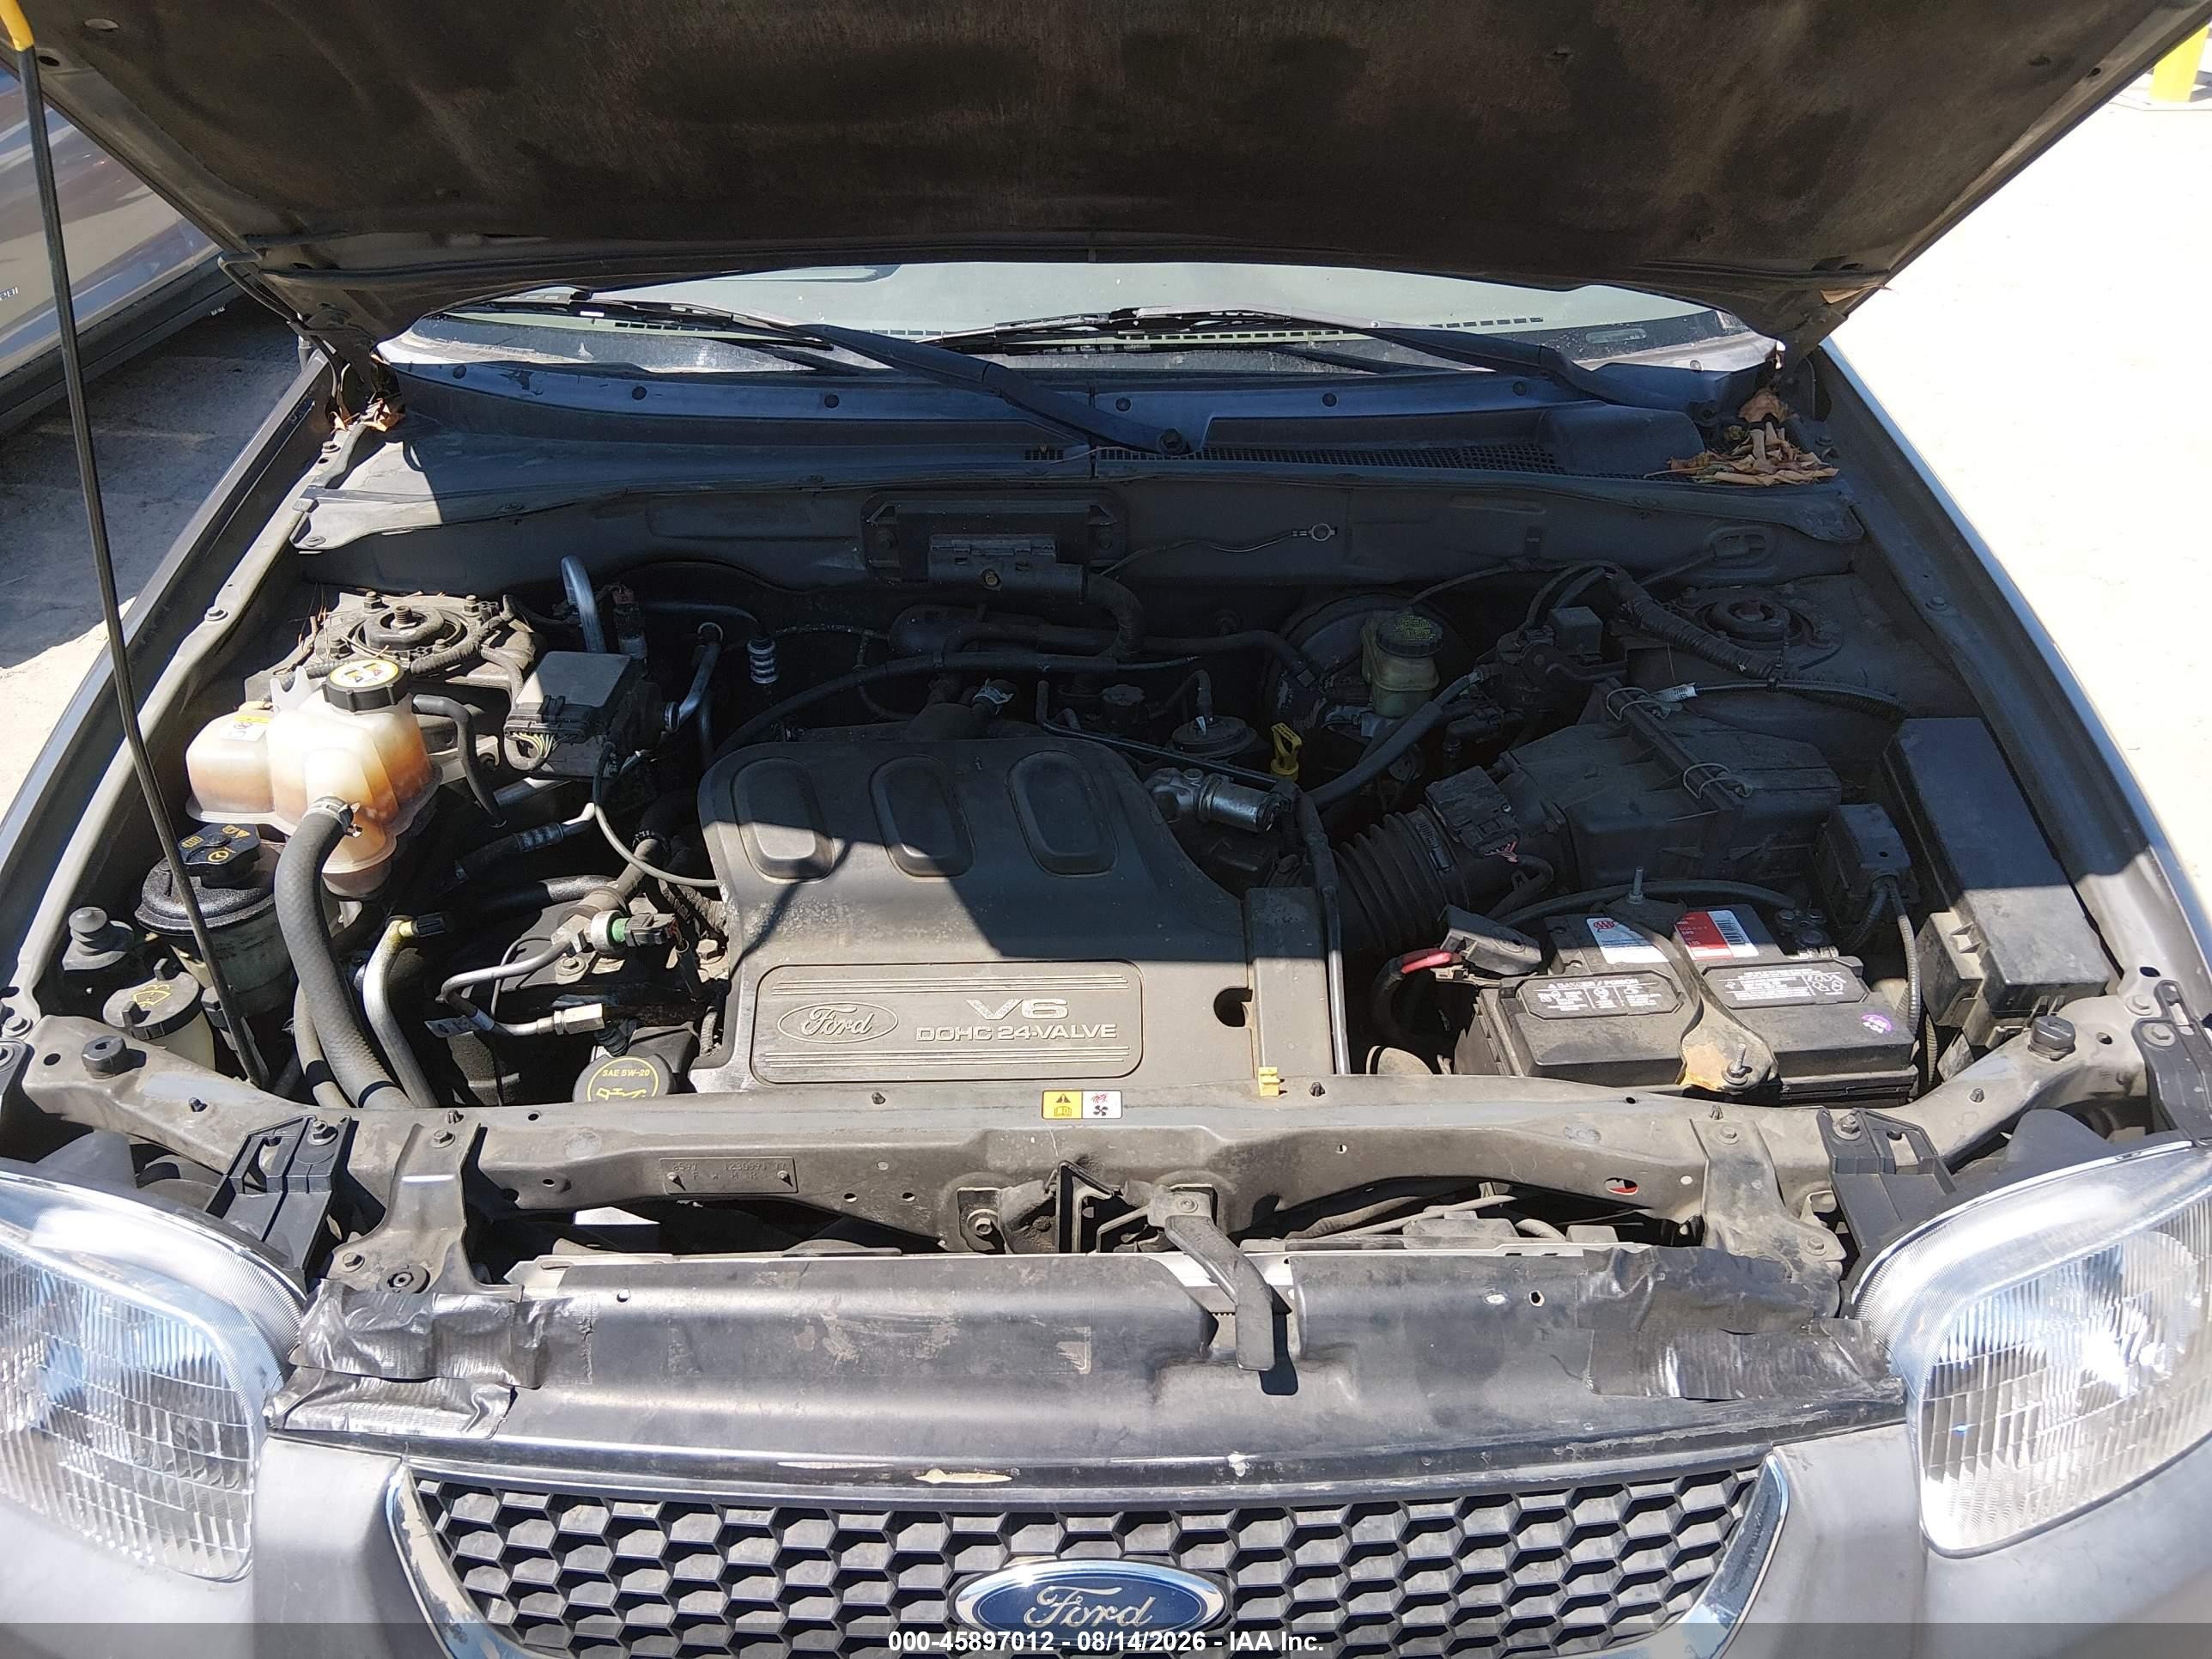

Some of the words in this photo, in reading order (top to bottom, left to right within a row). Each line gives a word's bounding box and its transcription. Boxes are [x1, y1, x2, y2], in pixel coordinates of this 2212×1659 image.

[801, 1006, 874, 1036] Ford
[965, 998, 1068, 1020] V6
[915, 1025, 994, 1042] DOHC
[997, 1023, 1118, 1040] 24-VALVE
[1024, 1585, 1157, 1628] Ford
